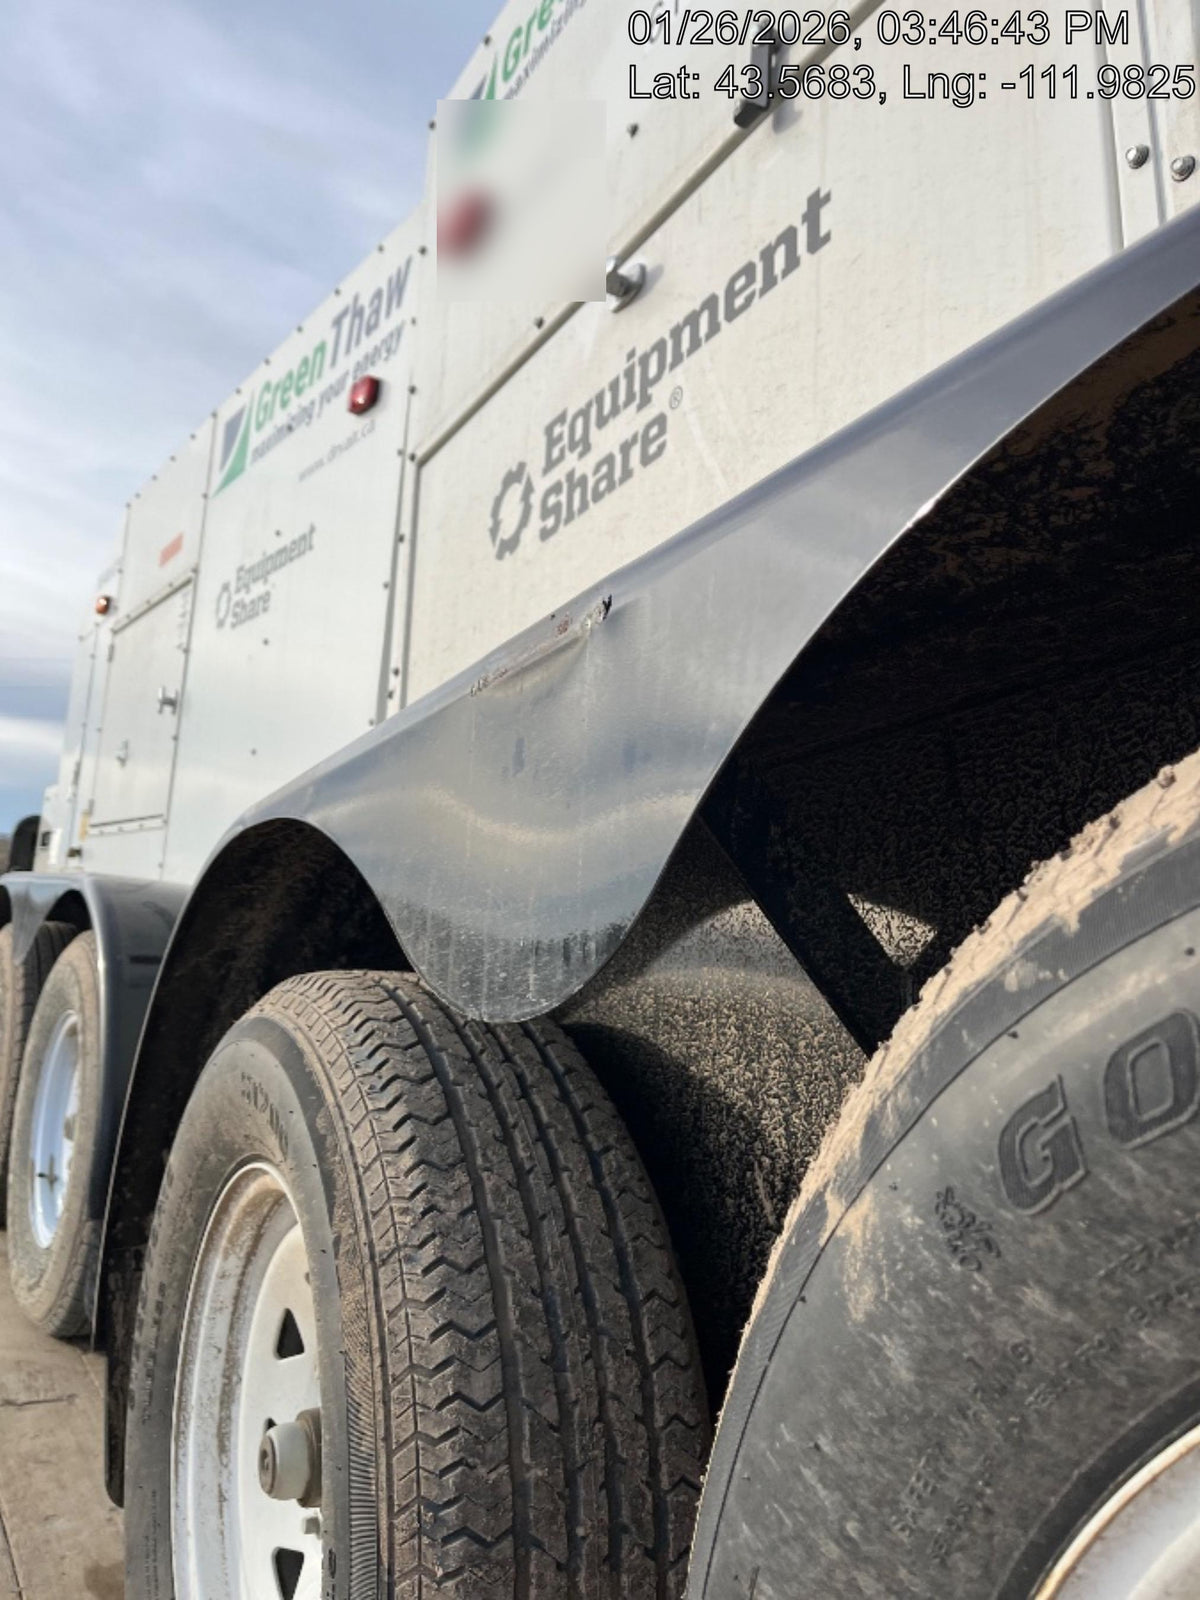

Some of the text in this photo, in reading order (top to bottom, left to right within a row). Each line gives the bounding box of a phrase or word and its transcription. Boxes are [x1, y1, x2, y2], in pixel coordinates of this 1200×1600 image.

[541, 186, 832, 477] Equipment
[538, 411, 668, 543] Share
[234, 522, 316, 595] Equipment
[230, 590, 271, 630] Share
